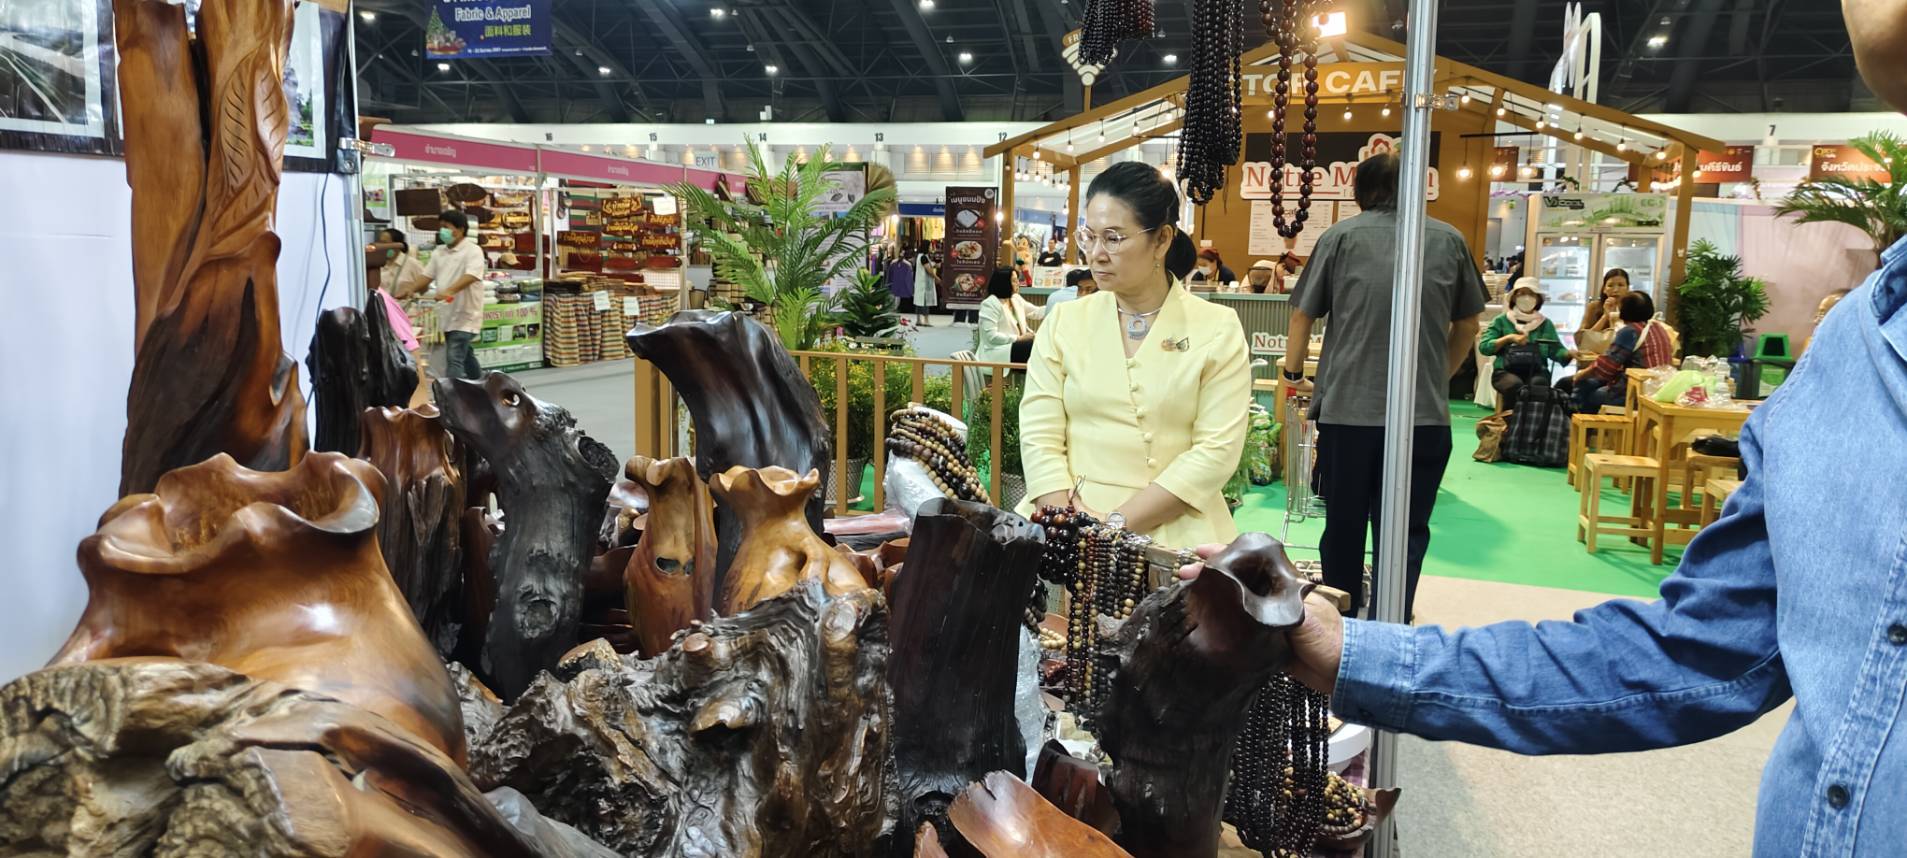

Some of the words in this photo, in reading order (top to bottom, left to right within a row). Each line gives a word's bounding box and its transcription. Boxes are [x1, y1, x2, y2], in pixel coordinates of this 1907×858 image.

[455, 7, 484, 21] Fabric
[485, 6, 494, 20] &
[495, 4, 531, 22] Apparel
[1769, 124, 1776, 136] 7
[649, 132, 658, 141] 15
[758, 132, 767, 142] 14
[874, 132, 884, 142] 13
[695, 156, 715, 167] EXIT
[1254, 335, 1288, 349] Not
